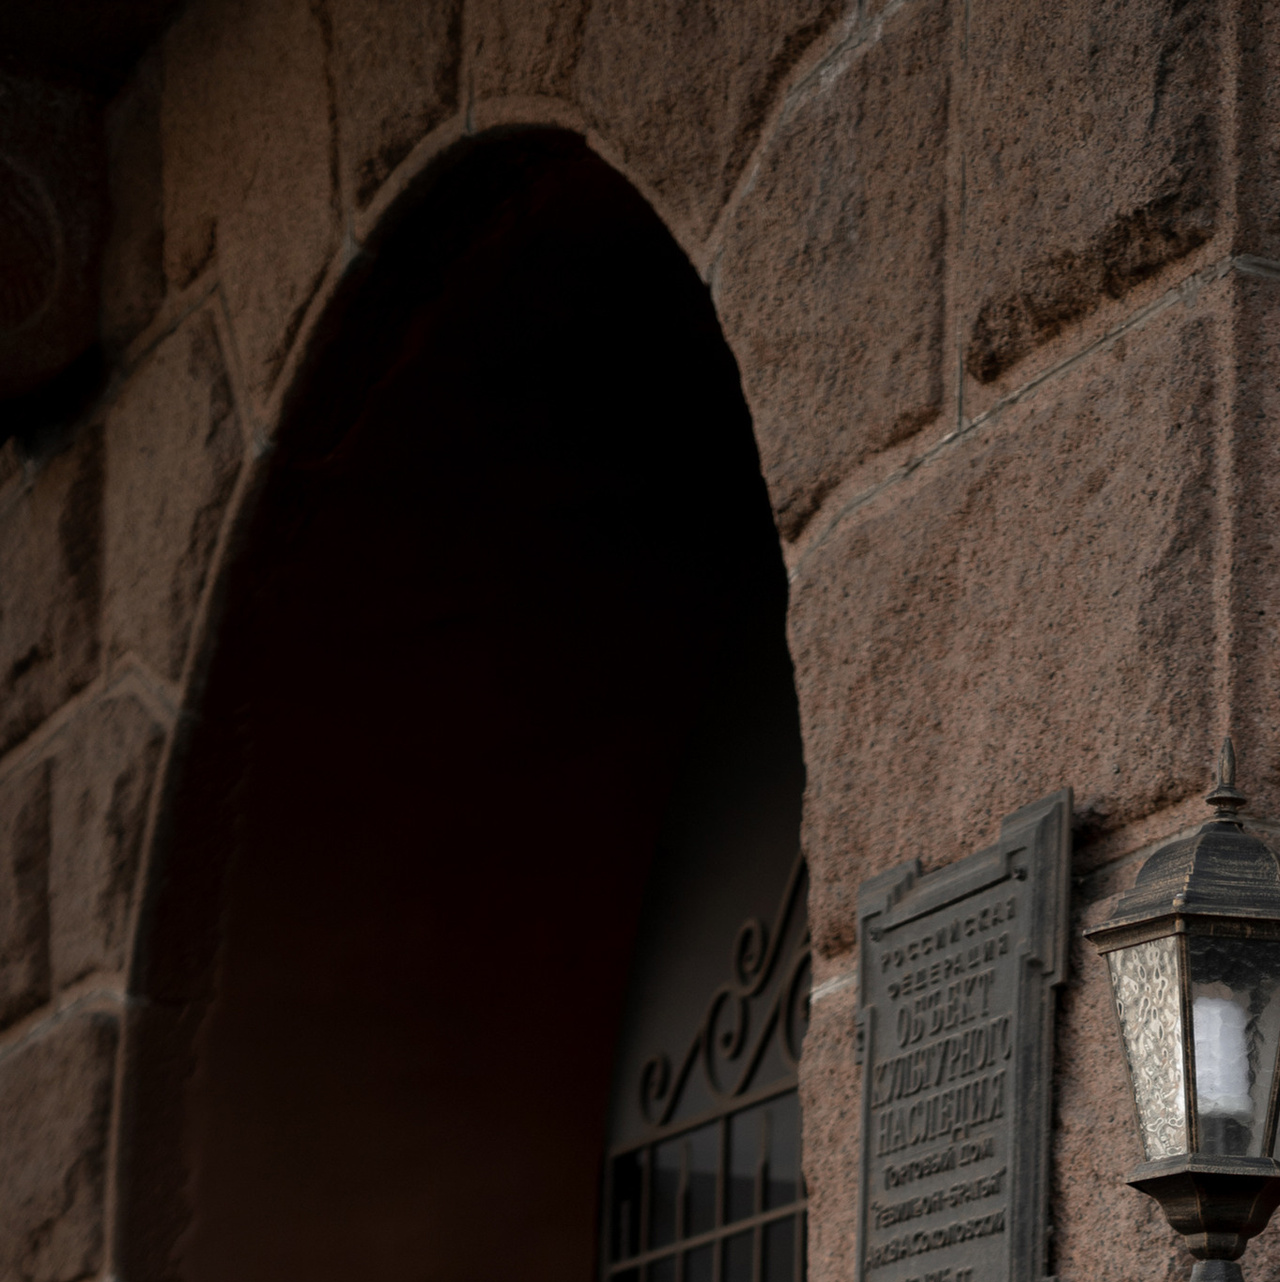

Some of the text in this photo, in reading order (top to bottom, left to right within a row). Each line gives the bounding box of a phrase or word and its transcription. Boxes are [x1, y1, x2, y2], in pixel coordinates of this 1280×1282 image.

[880, 896, 1016, 974] РОССИЙСКАЯ
[887, 931, 1009, 1000] ФЕДЕРАЦИЯ
[897, 968, 995, 1047] ОБЪЕКТ
[871, 1013, 1013, 1110] КУЛЬТУРНОГО
[877, 1069, 1005, 1157] НАСЛЕДИЯ
